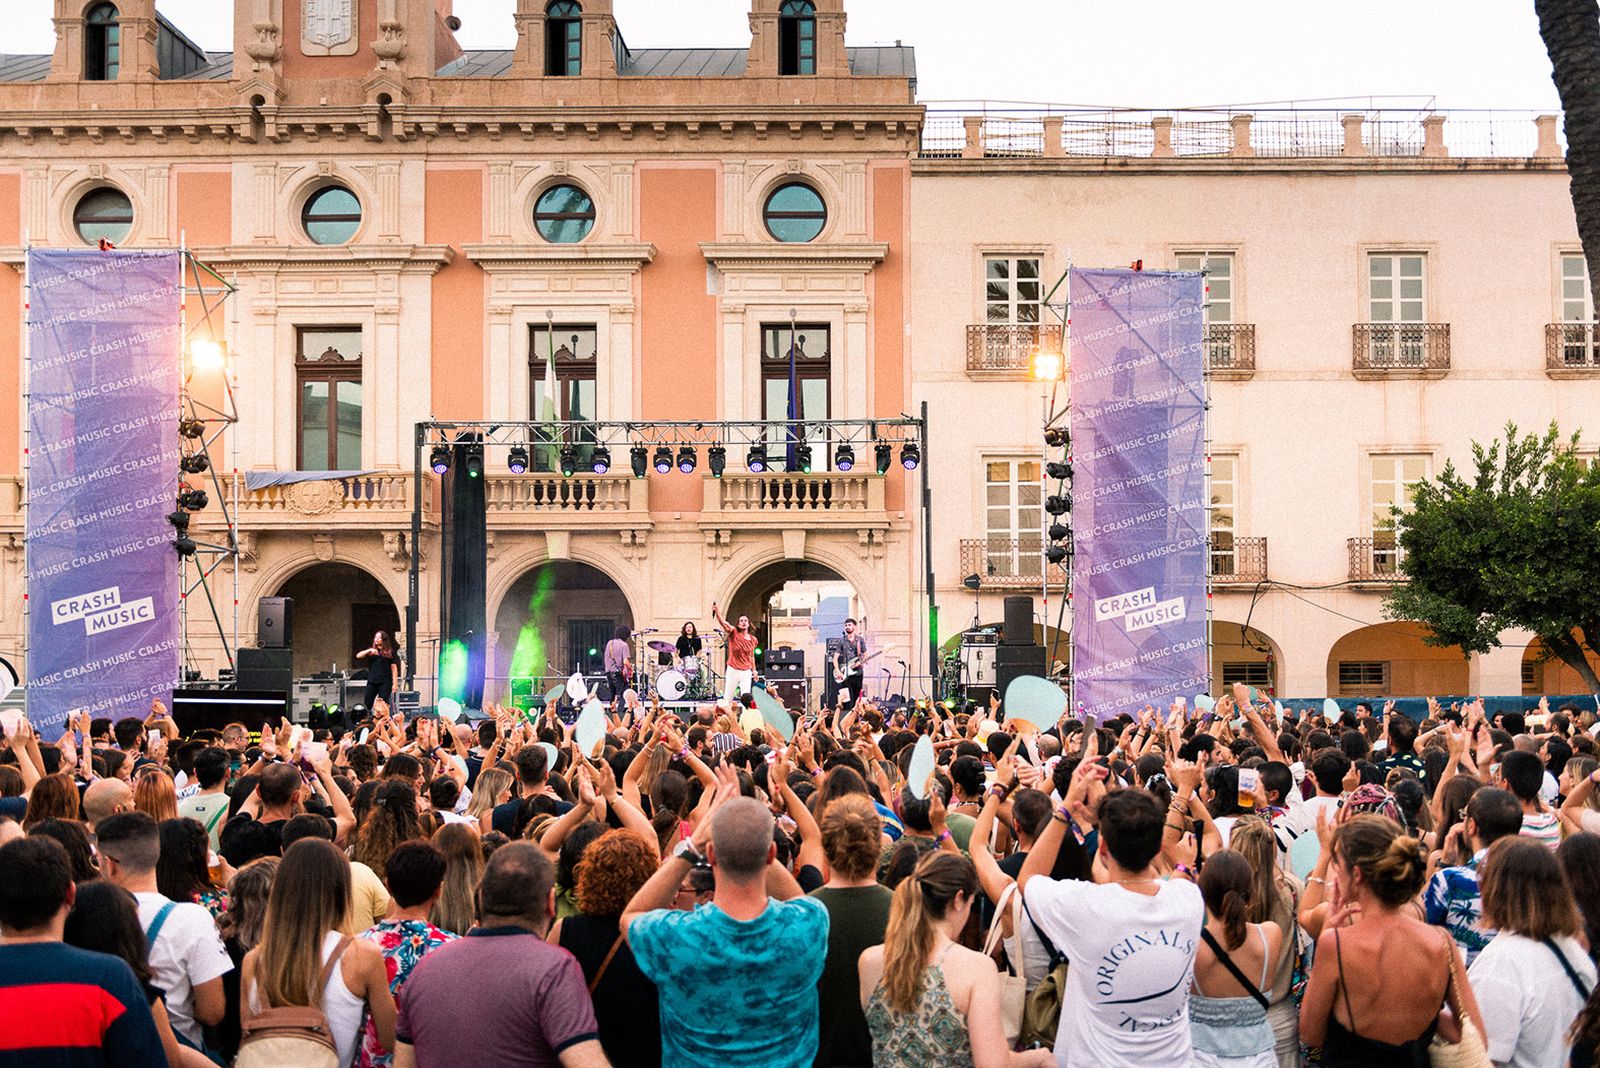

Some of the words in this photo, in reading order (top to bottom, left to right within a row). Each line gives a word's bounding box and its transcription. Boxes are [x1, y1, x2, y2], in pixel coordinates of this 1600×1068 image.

[32, 274, 66, 291] MUSIC
[68, 265, 105, 281] CRASH
[106, 256, 140, 272] MUSIC
[1073, 292, 1104, 307] MUSIC
[1105, 284, 1136, 298] CRASH
[1138, 275, 1168, 290] MUSIC
[44, 312, 77, 328] MUSIC
[79, 302, 116, 318] CRASH
[117, 293, 150, 308] MUSIC
[1083, 327, 1114, 342] MUSIC
[1115, 319, 1148, 334] CRASH
[1148, 310, 1178, 325] MUSIC
[54, 350, 88, 365] MUSIC
[90, 338, 127, 355] CRASH
[128, 329, 162, 345] MUSIC
[1093, 362, 1124, 378] MUSIC
[1125, 353, 1158, 369] CRASH
[1159, 344, 1189, 359] MUSIC
[30, 398, 66, 413] CRASH
[66, 387, 99, 404] MUSIC
[101, 377, 138, 392] CRASH
[139, 366, 174, 383] MUSIC
[1104, 398, 1134, 414] MUSIC
[1136, 390, 1168, 405] CRASH
[1169, 380, 1200, 396] MUSIC
[40, 438, 76, 454] CRASH
[77, 426, 111, 444] MUSIC
[112, 418, 149, 434] CRASH
[1082, 446, 1115, 461] CRASH
[1116, 437, 1146, 452] MUSIC
[1146, 428, 1179, 444] CRASH
[50, 476, 86, 492] CRASH
[88, 464, 122, 482] MUSIC
[124, 455, 160, 471] CRASH
[1092, 482, 1125, 498] CRASH
[1126, 472, 1156, 488] MUSIC
[1157, 463, 1189, 479] CRASH
[28, 524, 58, 540] MUSIC
[60, 514, 98, 530] CRASH
[99, 502, 134, 520] MUSIC
[135, 492, 172, 509] CRASH
[1103, 517, 1135, 533] CRASH
[1136, 508, 1167, 524] MUSIC
[1168, 499, 1200, 514] CRASH
[36, 561, 70, 578] MUSIC
[72, 550, 109, 568] CRASH
[110, 540, 144, 558] MUSIC
[1081, 563, 1112, 578] MUSIC
[1112, 553, 1145, 569] CRASH
[1146, 544, 1177, 560] MUSIC
[56, 592, 116, 616] CRASH
[92, 605, 149, 630] MUSIC
[1099, 592, 1151, 614] CRASH
[1132, 605, 1180, 628] MUSIC
[28, 672, 62, 688] MUSIC
[64, 661, 101, 679] CRASH
[102, 650, 137, 668] MUSIC
[138, 640, 175, 657] CRASH
[1074, 666, 1104, 680] MUSIC
[1105, 656, 1138, 672] CRASH
[1140, 647, 1171, 663] MUSIC
[1172, 637, 1204, 653] CRASH
[116, 688, 148, 706] MUSIC
[1115, 692, 1148, 708] CRASH
[1150, 682, 1180, 698] MUSIC
[1096, 929, 1194, 996] ORIGINALS
